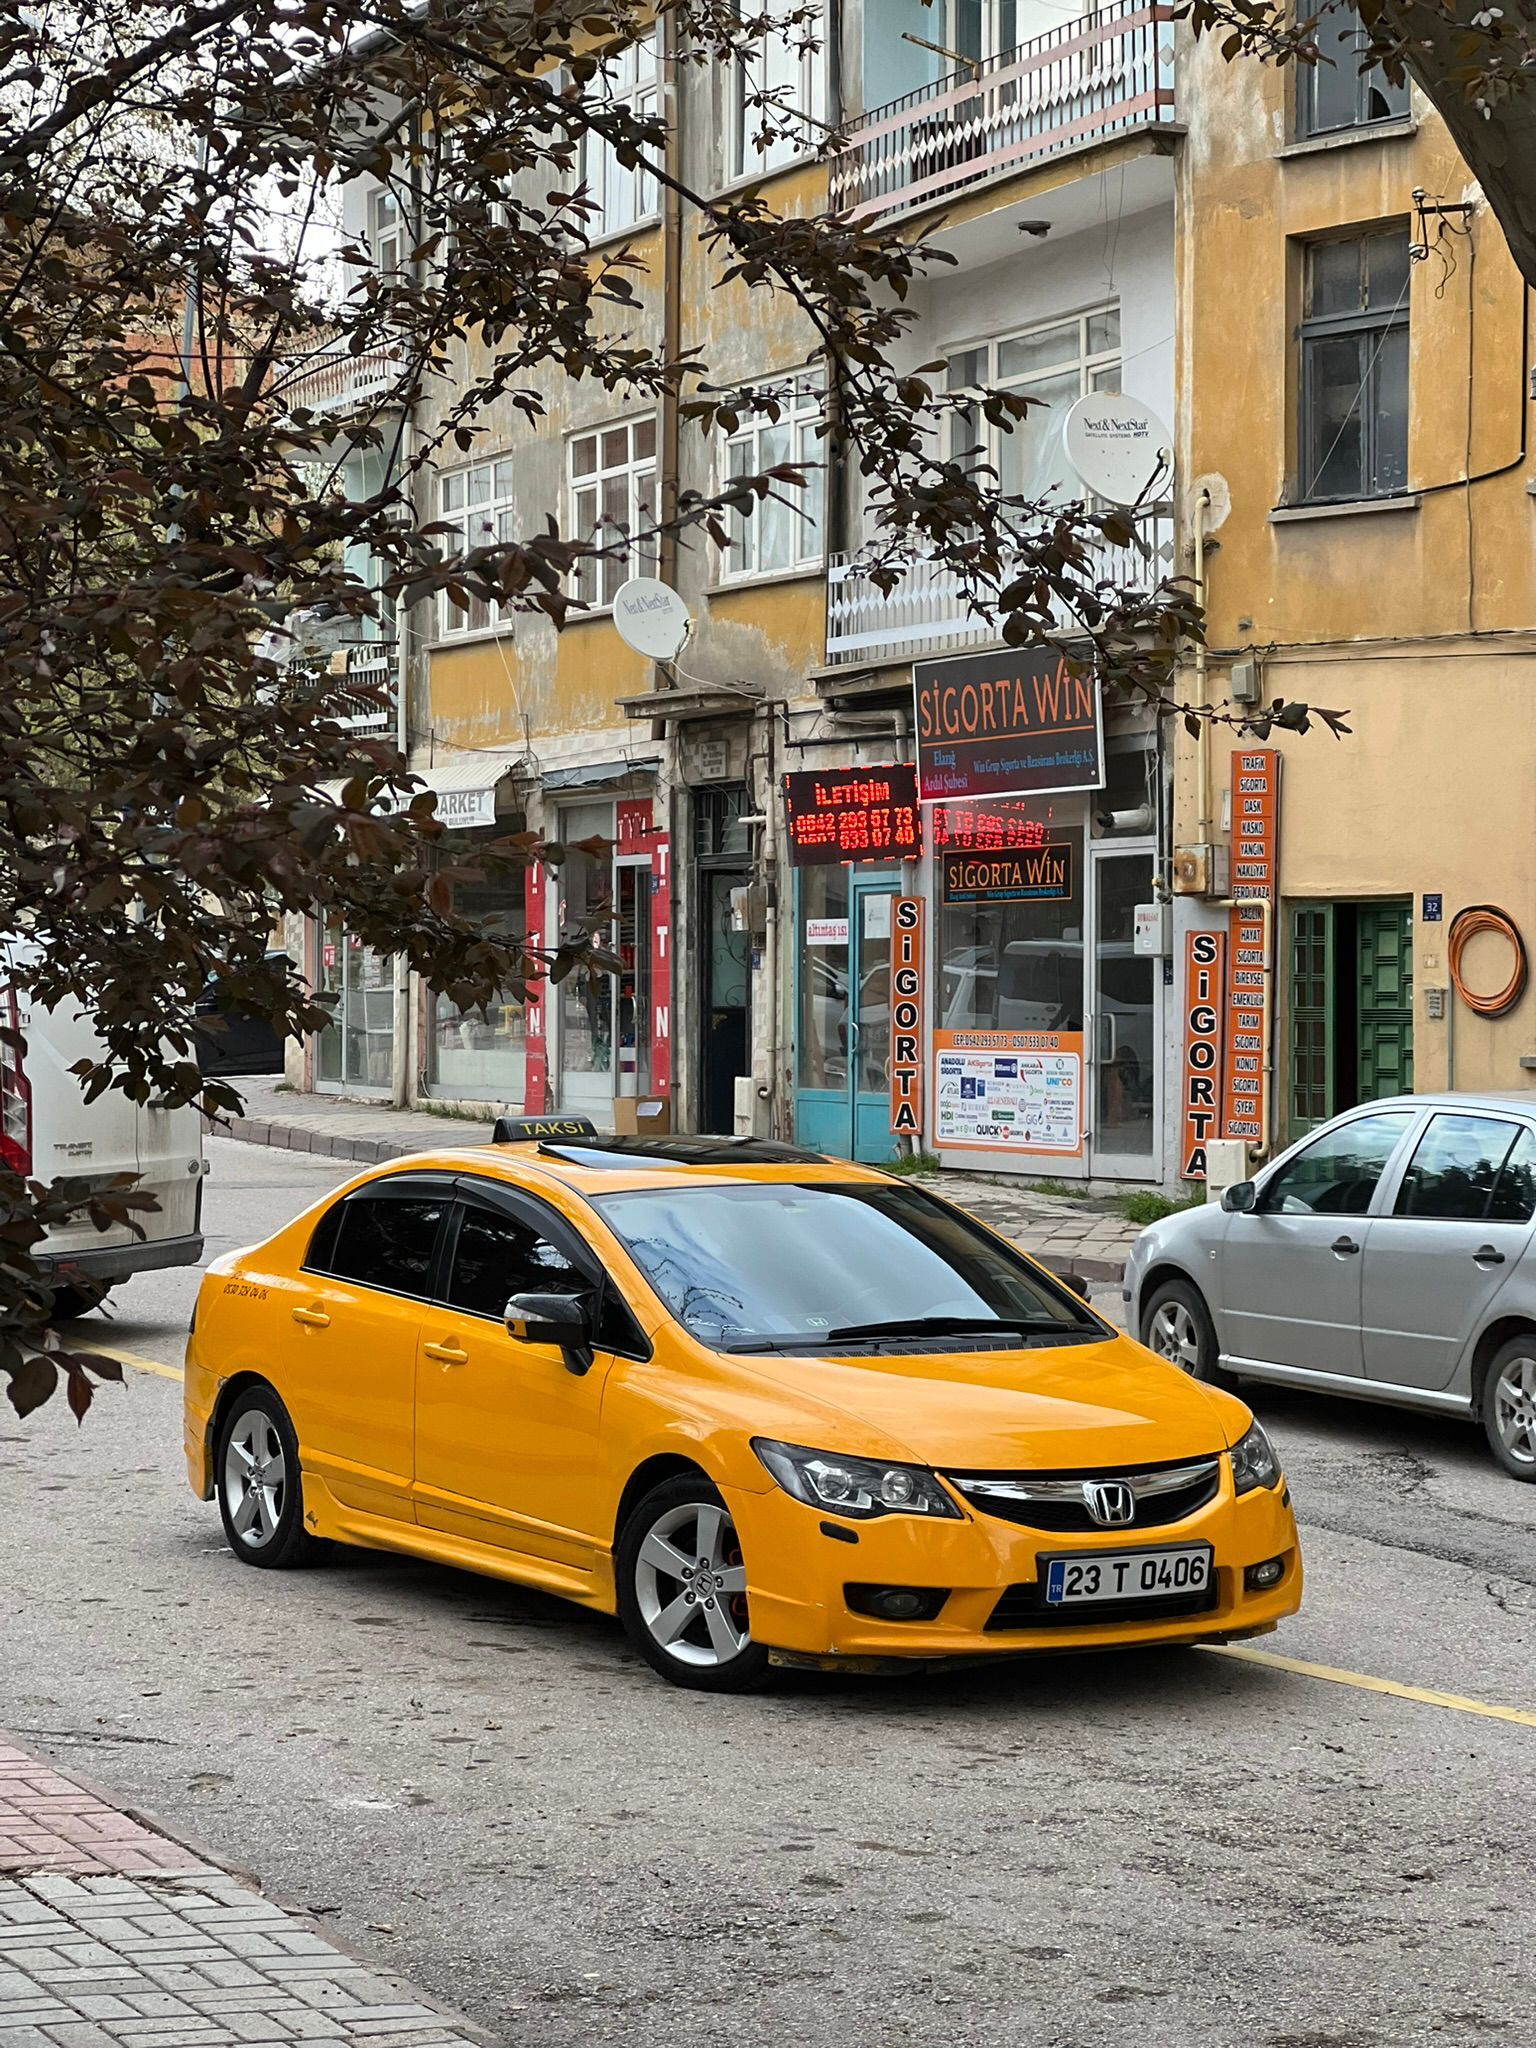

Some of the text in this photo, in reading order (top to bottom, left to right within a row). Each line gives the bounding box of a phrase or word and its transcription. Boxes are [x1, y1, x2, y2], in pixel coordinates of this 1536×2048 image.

[919, 655, 1093, 738] SİGORTA WİN
[1241, 757, 1266, 771] TRAFİK
[815, 779, 890, 806] İLETİŞİM
[1240, 778, 1267, 793] SİGORTA
[1244, 800, 1262, 814] DASK
[1241, 822, 1264, 835] KASKO
[948, 847, 1065, 889] SİGORTA WİN
[1237, 865, 1267, 878] NAKLİYAT
[1252, 887, 1270, 900] KAZA
[1426, 902, 1438, 912] 32
[1241, 929, 1261, 942] HAYAT
[895, 902, 918, 1129] SİGORTA
[1238, 1014, 1259, 1028] TARIM
[1235, 1035, 1261, 1049] SİGORTA
[1186, 935, 1216, 1175] SİGORTA
[1236, 1057, 1258, 1070] KONUT
[1233, 1078, 1259, 1092] SİGORTA
[941, 1111, 954, 1121] HDI
[520, 1121, 584, 1135] TAKSİ
[976, 1124, 999, 1136] QUICK
[1065, 1555, 1206, 1596] 23 T 0406
[1051, 1584, 1063, 1593] TR
